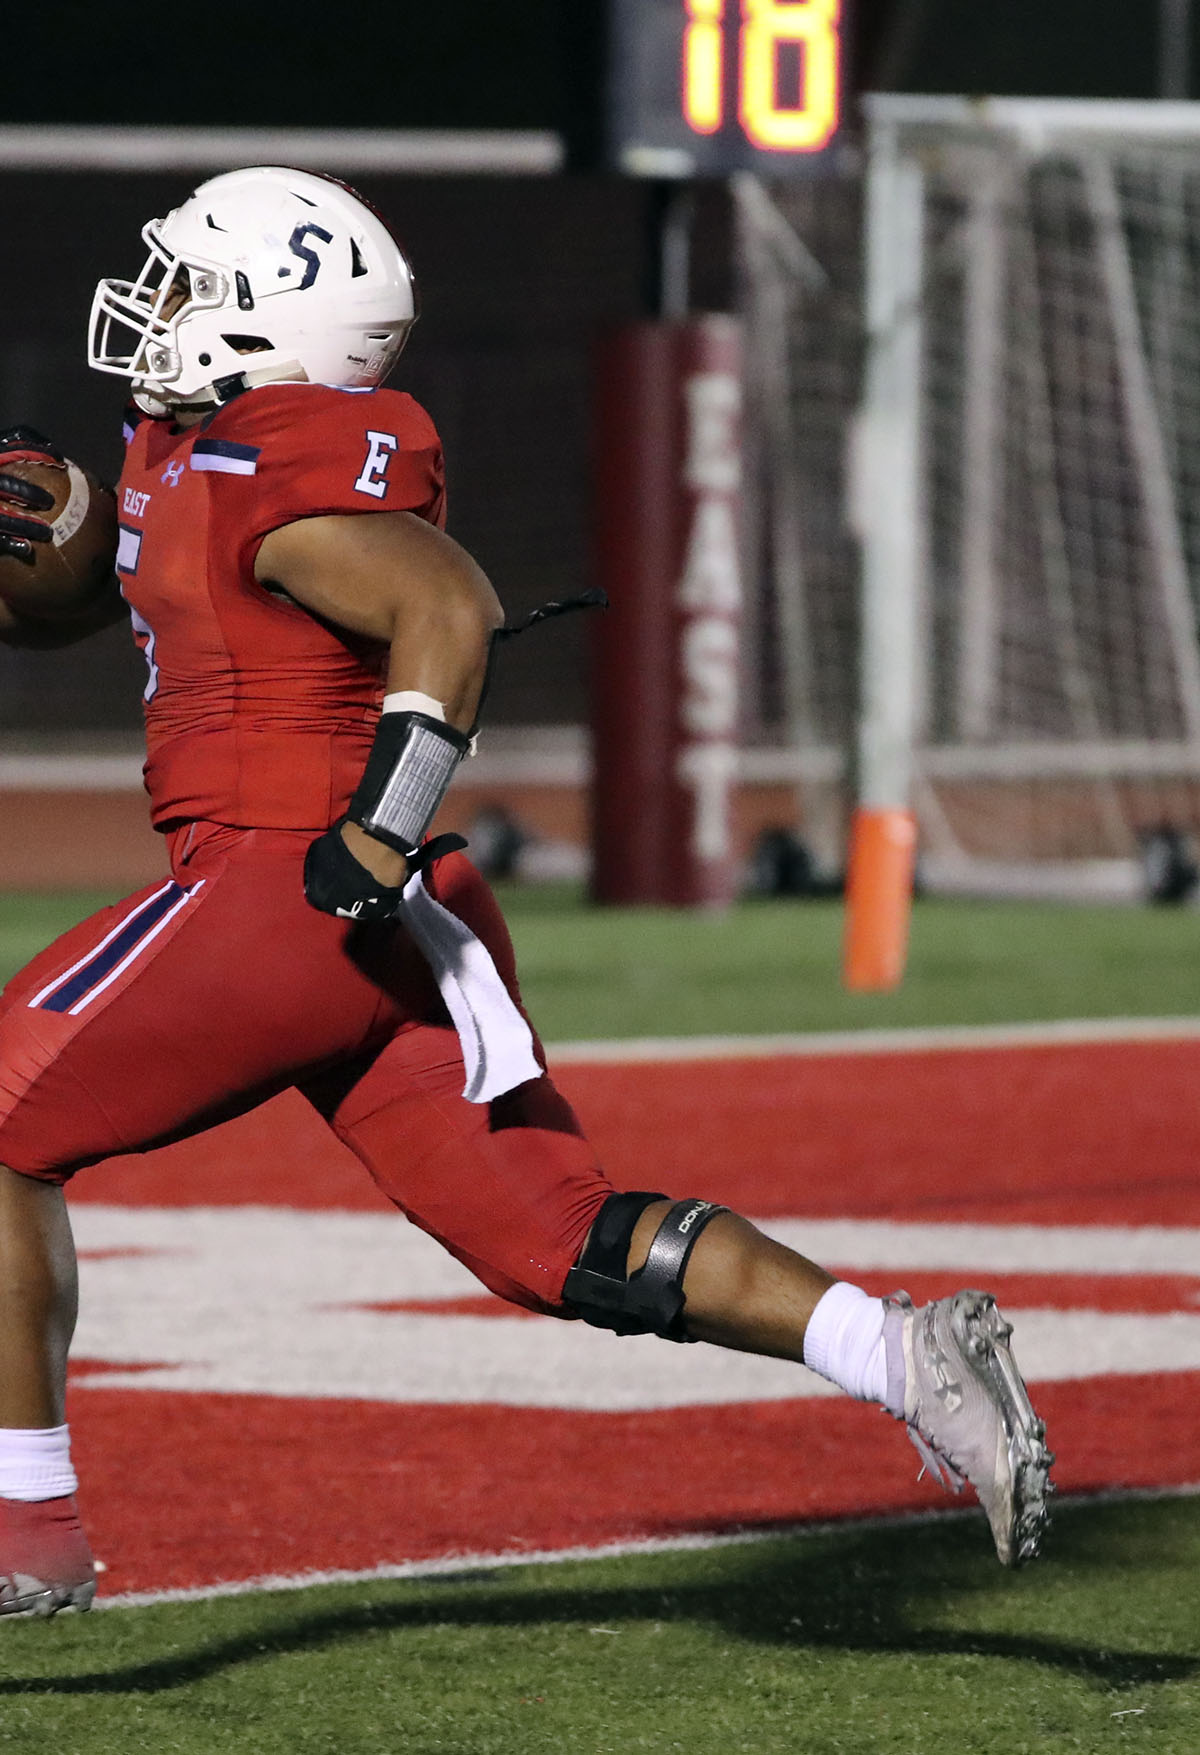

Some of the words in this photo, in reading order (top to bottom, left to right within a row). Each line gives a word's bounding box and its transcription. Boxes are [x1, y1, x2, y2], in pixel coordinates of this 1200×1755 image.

[278, 221, 333, 290] S
[353, 430, 399, 499] E
[123, 488, 151, 518] EAST
[676, 371, 744, 860] EAST
